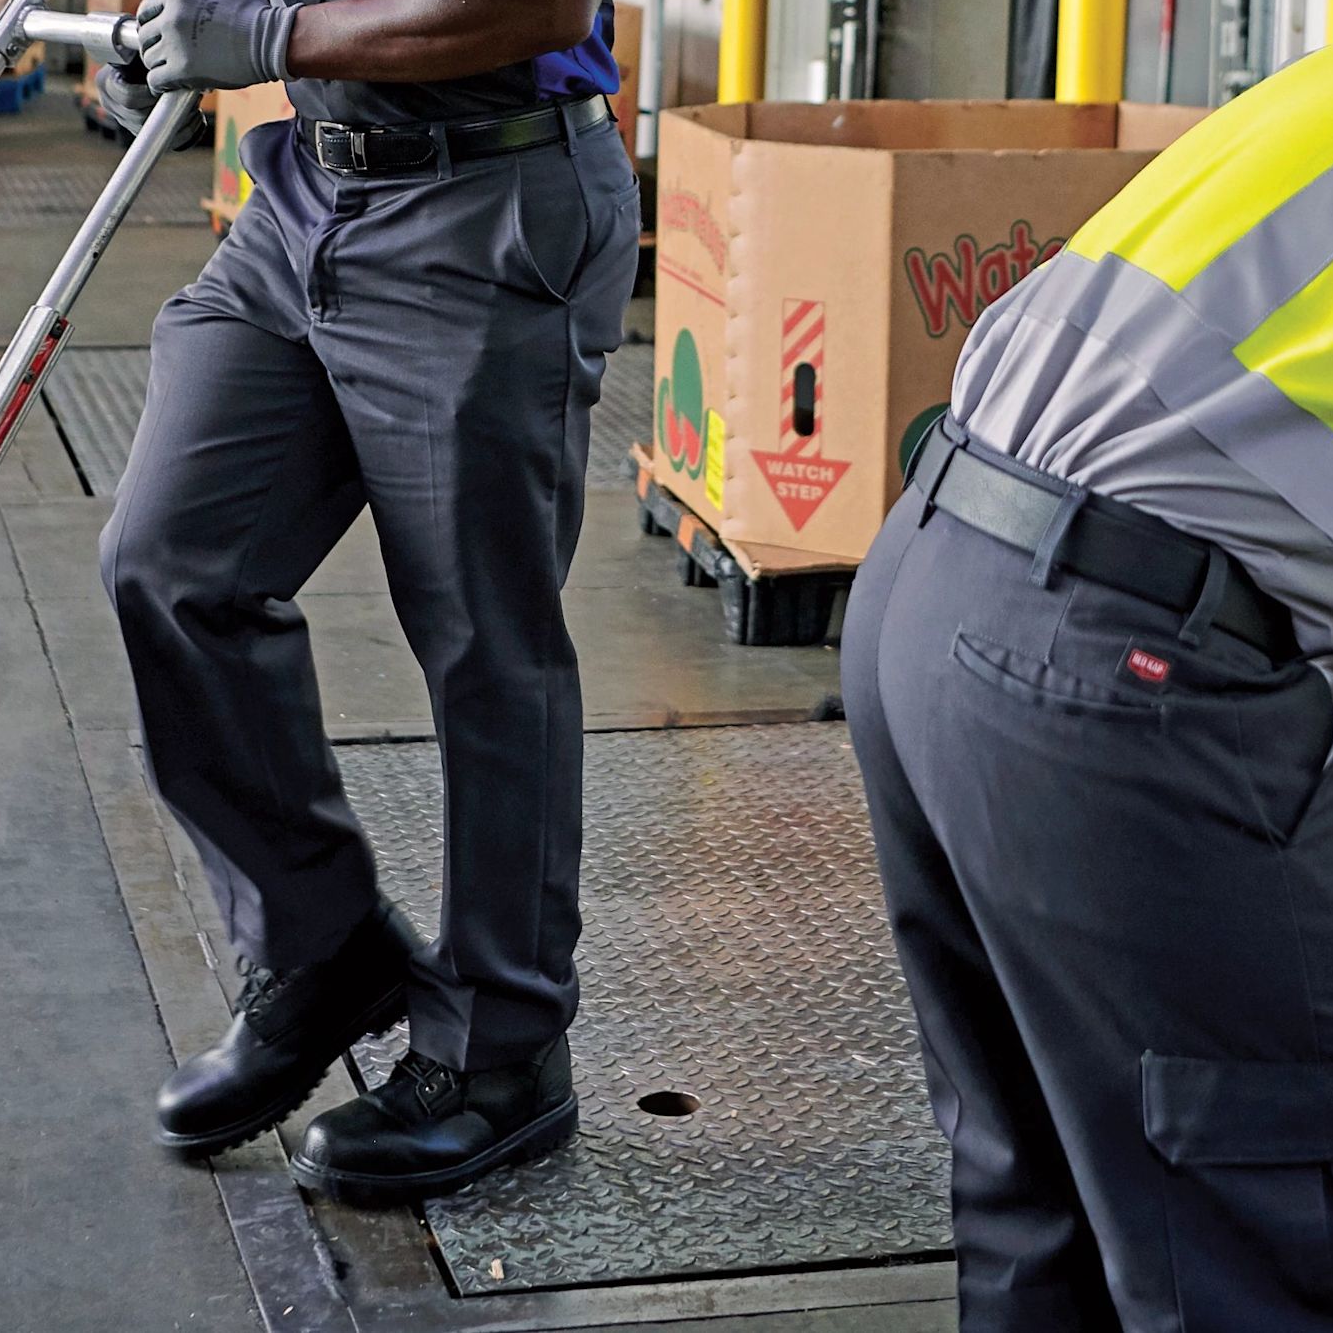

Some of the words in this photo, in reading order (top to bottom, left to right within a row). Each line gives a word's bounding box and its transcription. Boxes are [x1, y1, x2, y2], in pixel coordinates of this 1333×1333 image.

[904, 219, 1069, 338] Wat
[766, 460, 834, 482] WATCH
[776, 481, 823, 500] STEP
